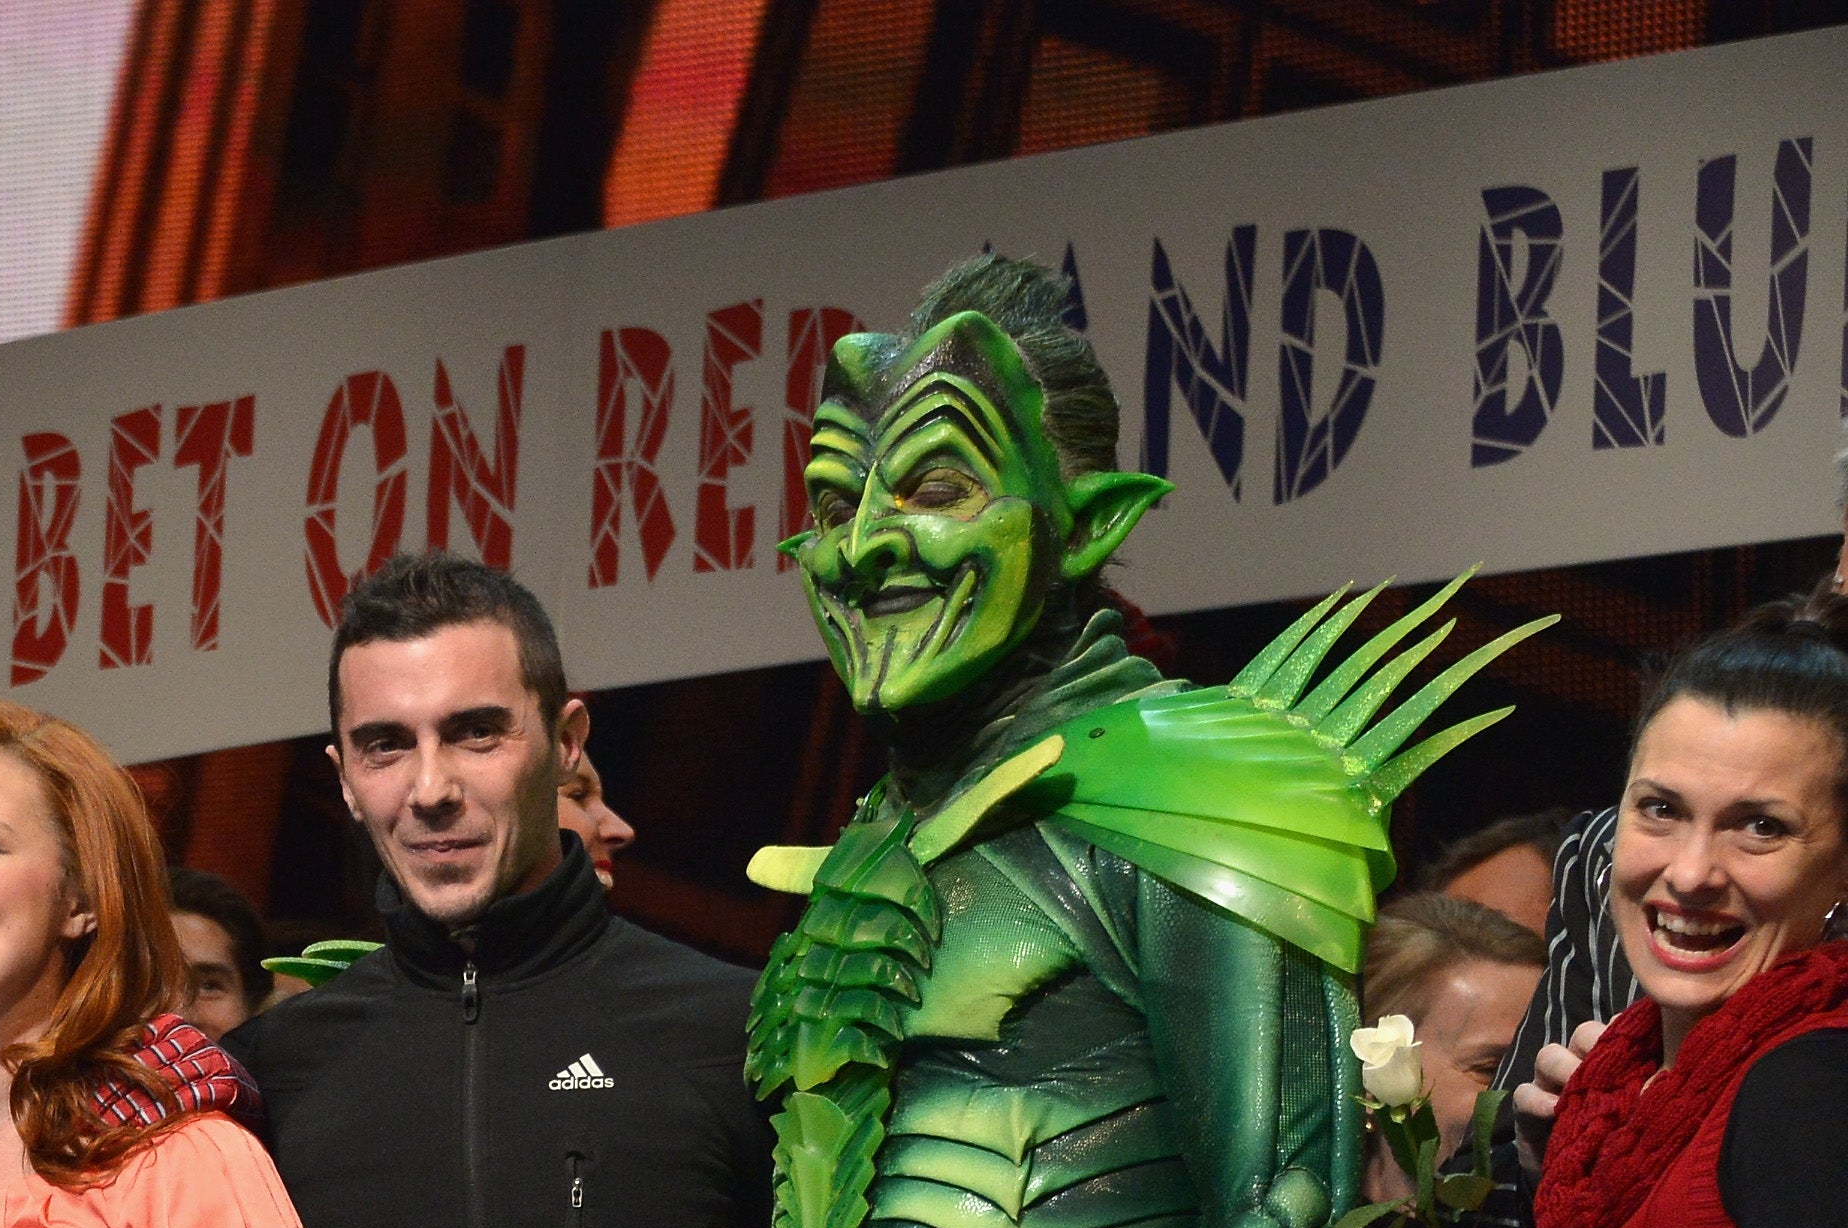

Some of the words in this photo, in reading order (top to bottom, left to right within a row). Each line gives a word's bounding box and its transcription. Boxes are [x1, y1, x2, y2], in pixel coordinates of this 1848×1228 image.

[10, 394, 257, 687] BET
[304, 344, 526, 631] ON
[1059, 224, 1385, 509] ND
[1470, 136, 1848, 469] BLU
[548, 1075, 615, 1090] adidas
